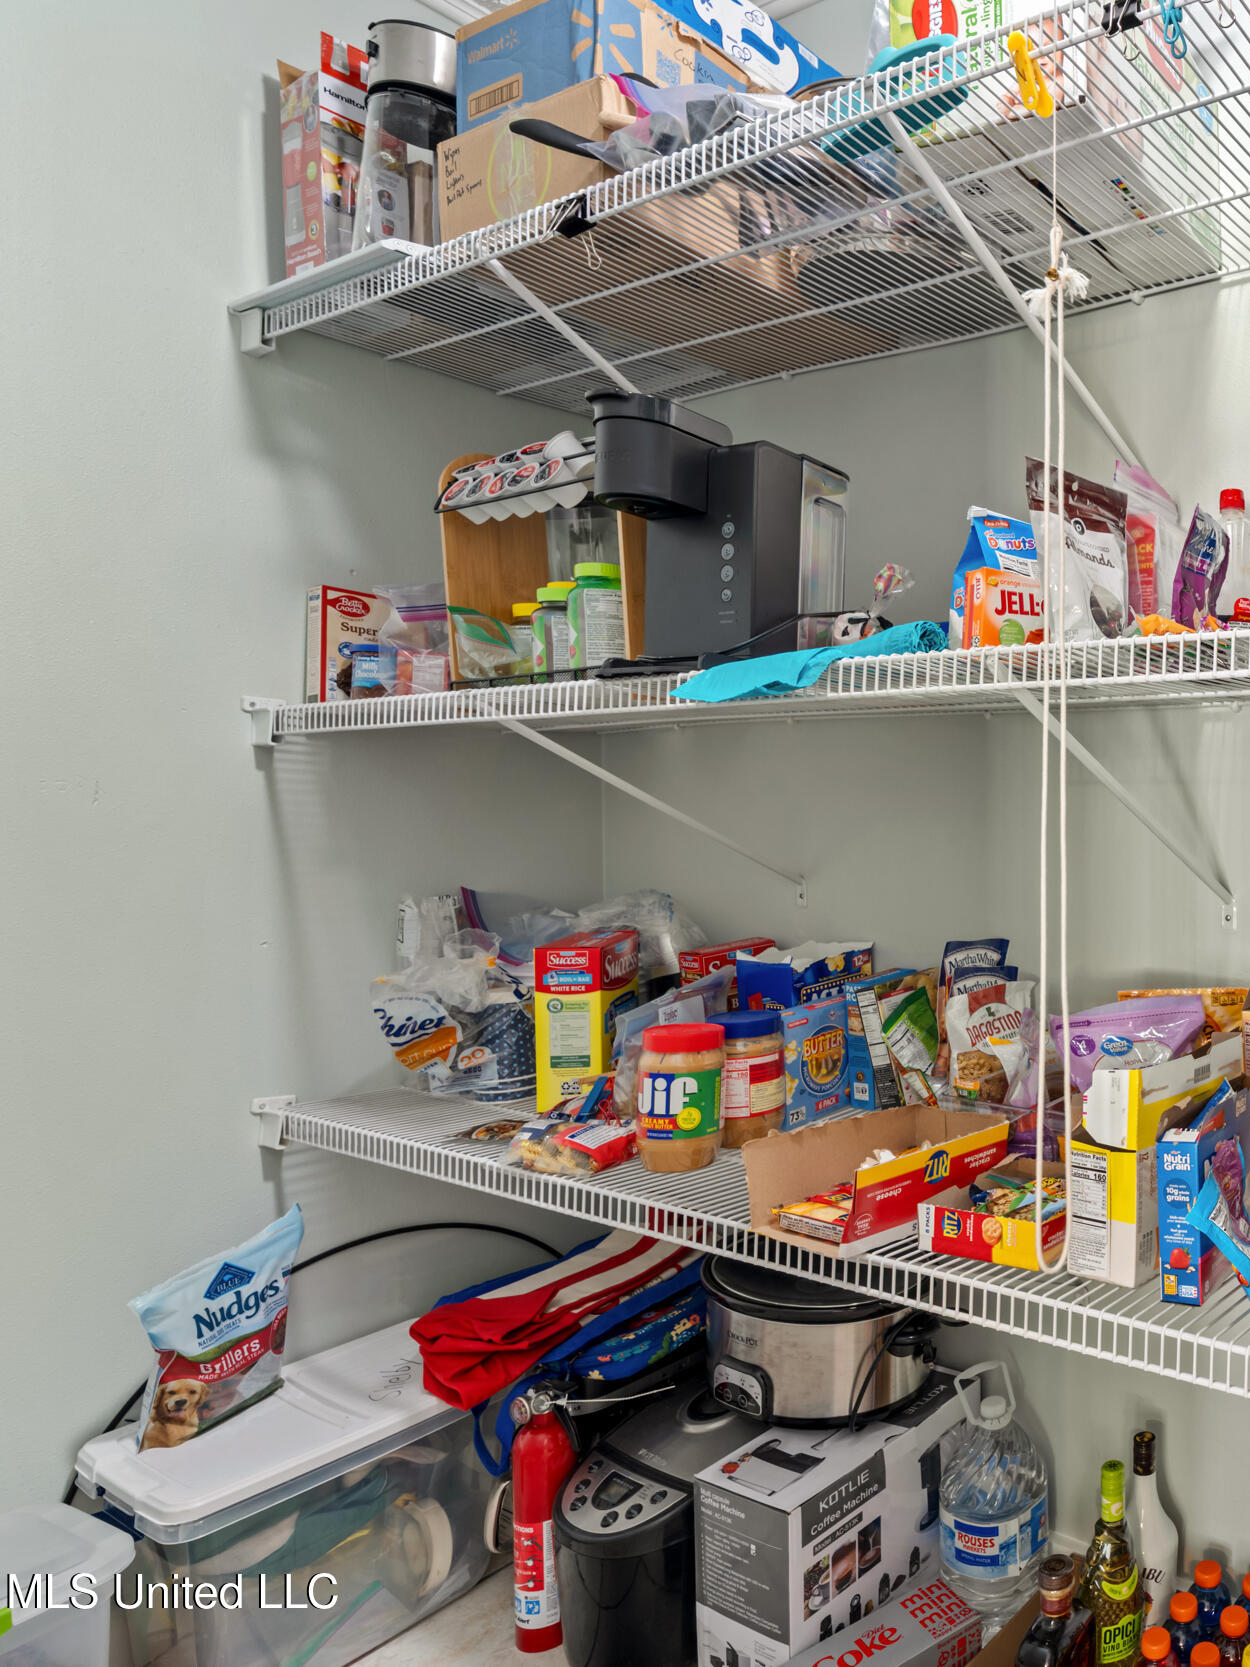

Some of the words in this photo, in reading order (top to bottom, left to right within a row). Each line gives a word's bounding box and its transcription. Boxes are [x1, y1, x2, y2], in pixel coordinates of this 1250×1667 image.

[467, 38, 504, 64] Walmart
[340, 621, 379, 638] Super
[549, 954, 587, 966] Success
[603, 951, 637, 984] Success
[803, 1028, 845, 1057] BUTTER
[637, 1076, 699, 1116] Jif
[923, 1152, 951, 1184] RITZ
[1092, 1154, 1107, 1162] Facts
[1163, 1153, 1191, 1165] Nutri
[1163, 1162, 1191, 1171] Grain
[875, 1187, 902, 1201] cheese
[1166, 1194, 1190, 1203] grains
[943, 1210, 959, 1239] RITZ
[216, 1277, 242, 1293] BLUE
[192, 1279, 280, 1340] Nudges
[199, 1338, 261, 1375] Grillers
[818, 1468, 870, 1513] KOTLIE
[810, 1509, 841, 1536] Coffee
[842, 1483, 879, 1511] Machine
[956, 1531, 996, 1549] ROUSES
[899, 1578, 946, 1610] mini
[908, 1586, 957, 1619] mini
[918, 1595, 968, 1630] mini
[1103, 1618, 1136, 1645] OPICI
